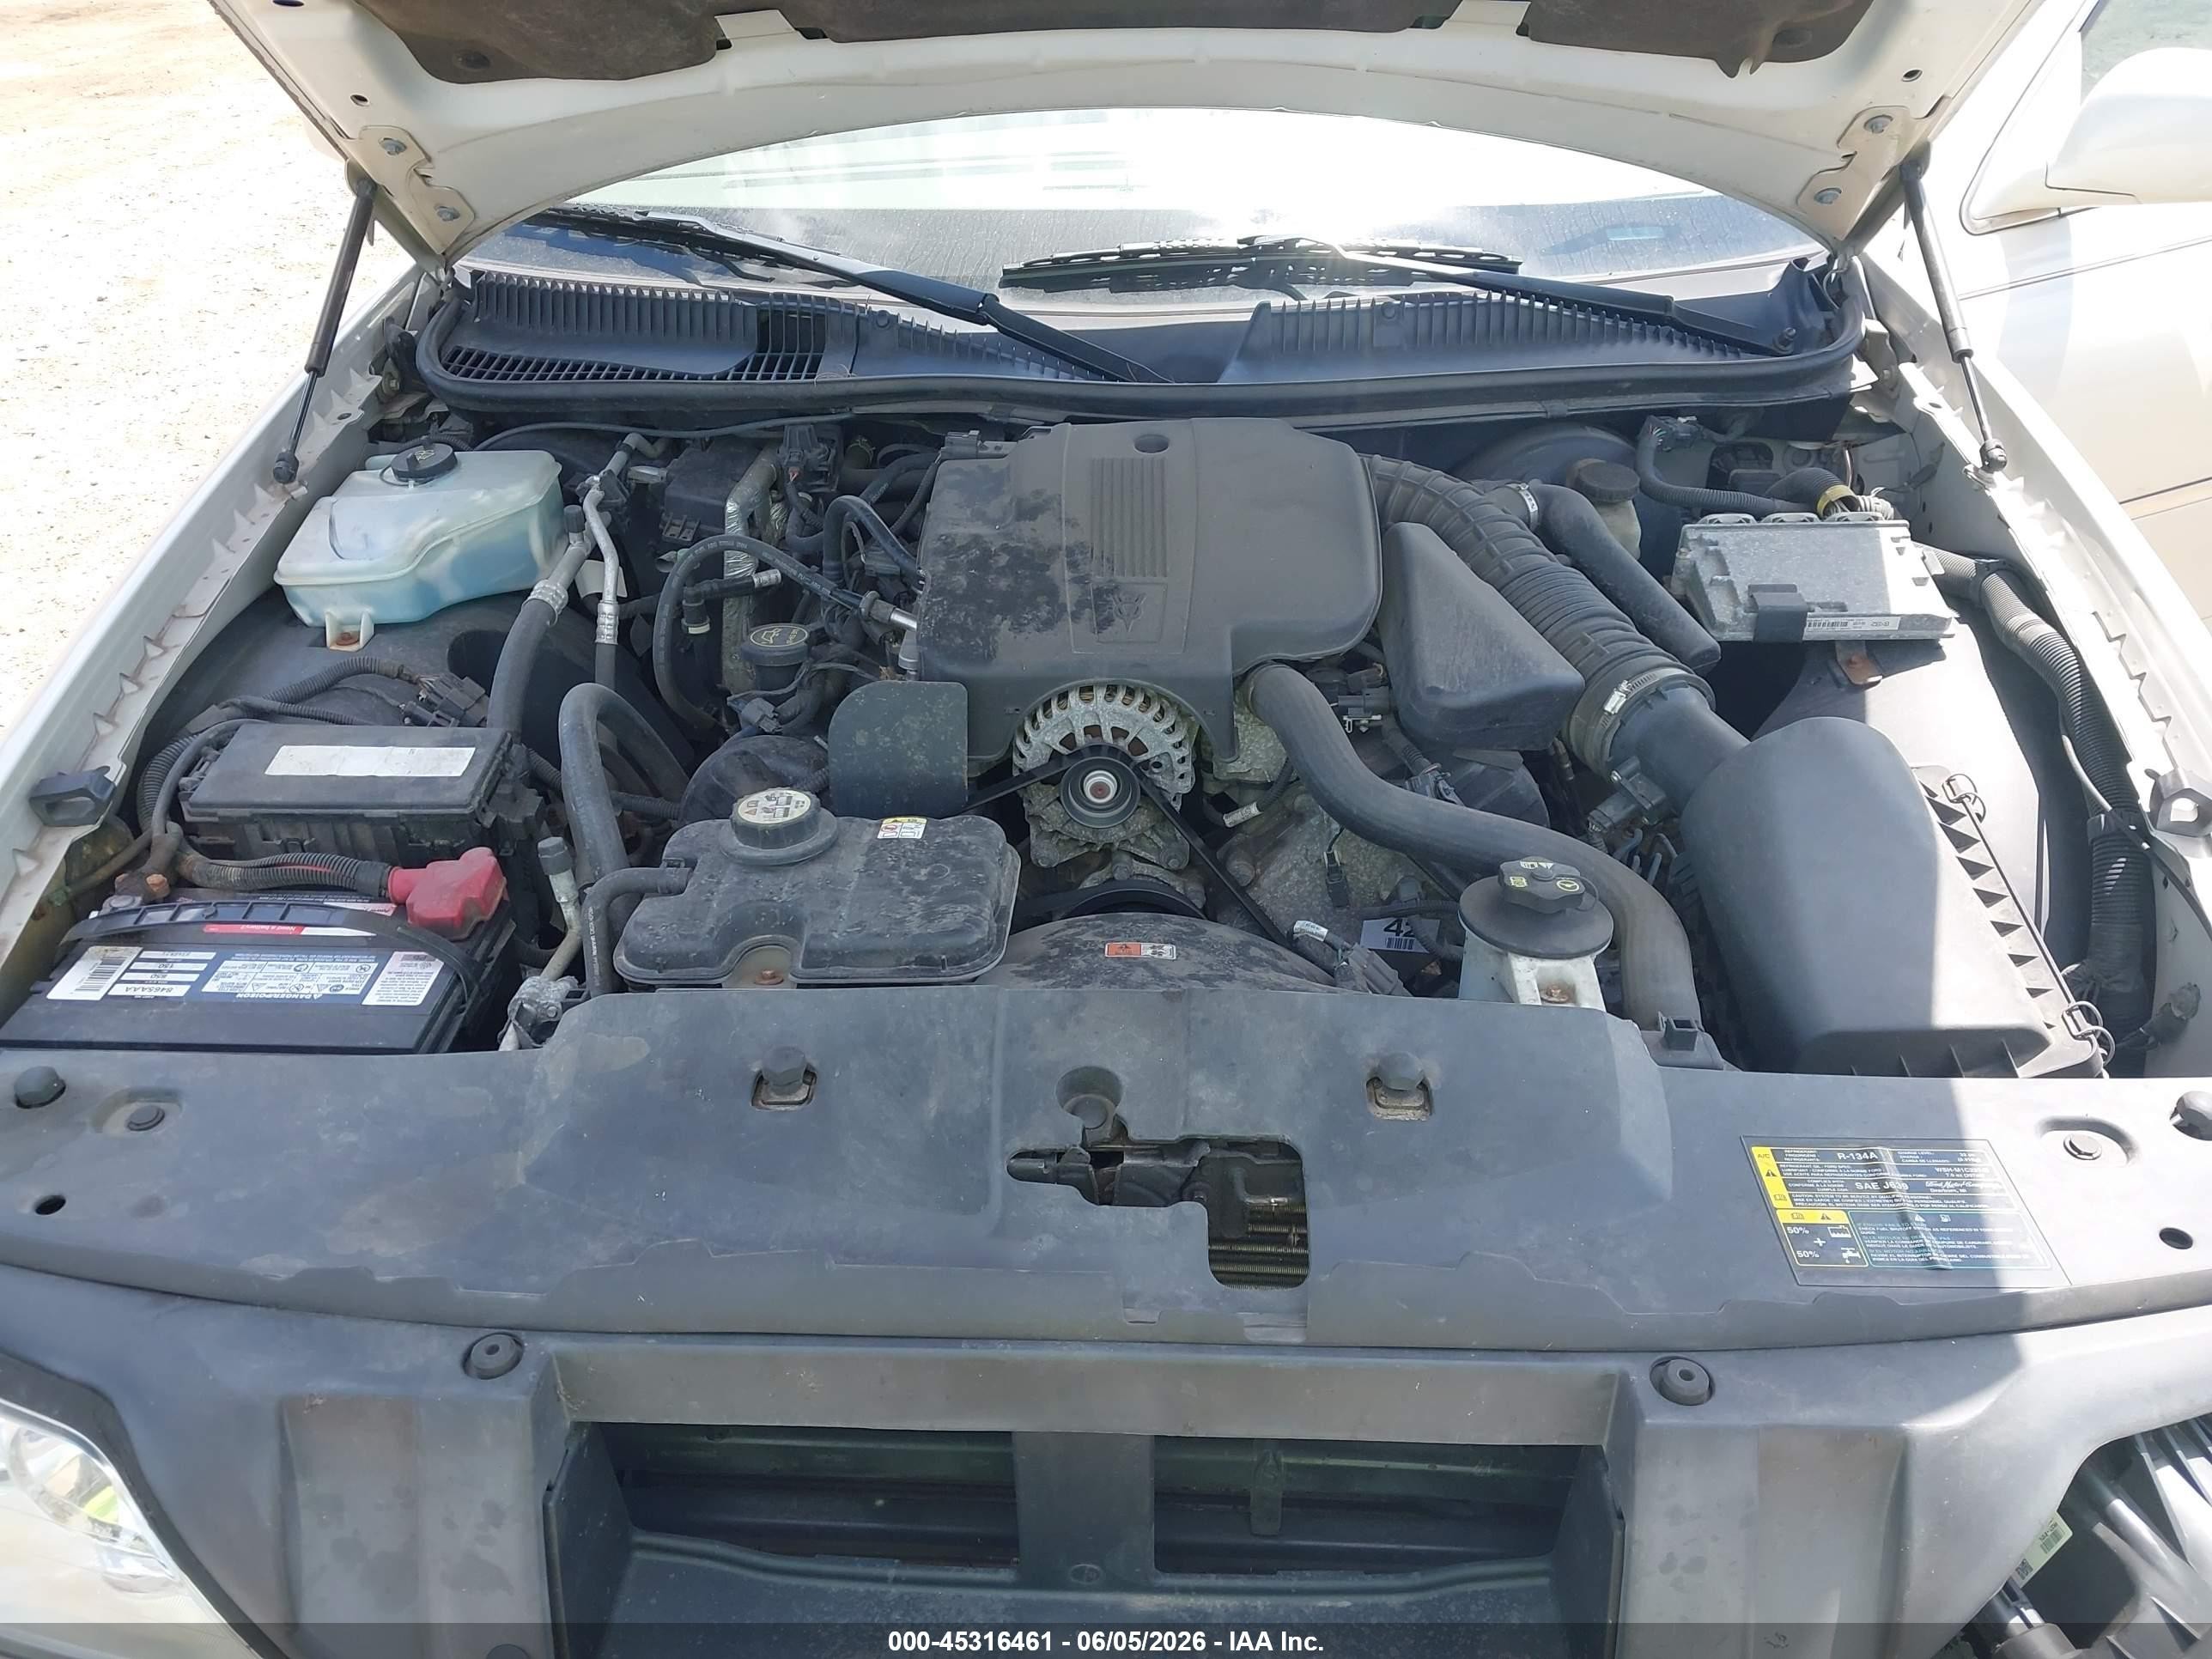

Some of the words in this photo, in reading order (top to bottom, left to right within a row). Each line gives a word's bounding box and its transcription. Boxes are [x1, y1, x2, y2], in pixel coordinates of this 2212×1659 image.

[1838, 1152, 1878, 1161] R-134A
[1855, 1182, 1881, 1190] SAE
[1883, 1182, 1909, 1190] J639
